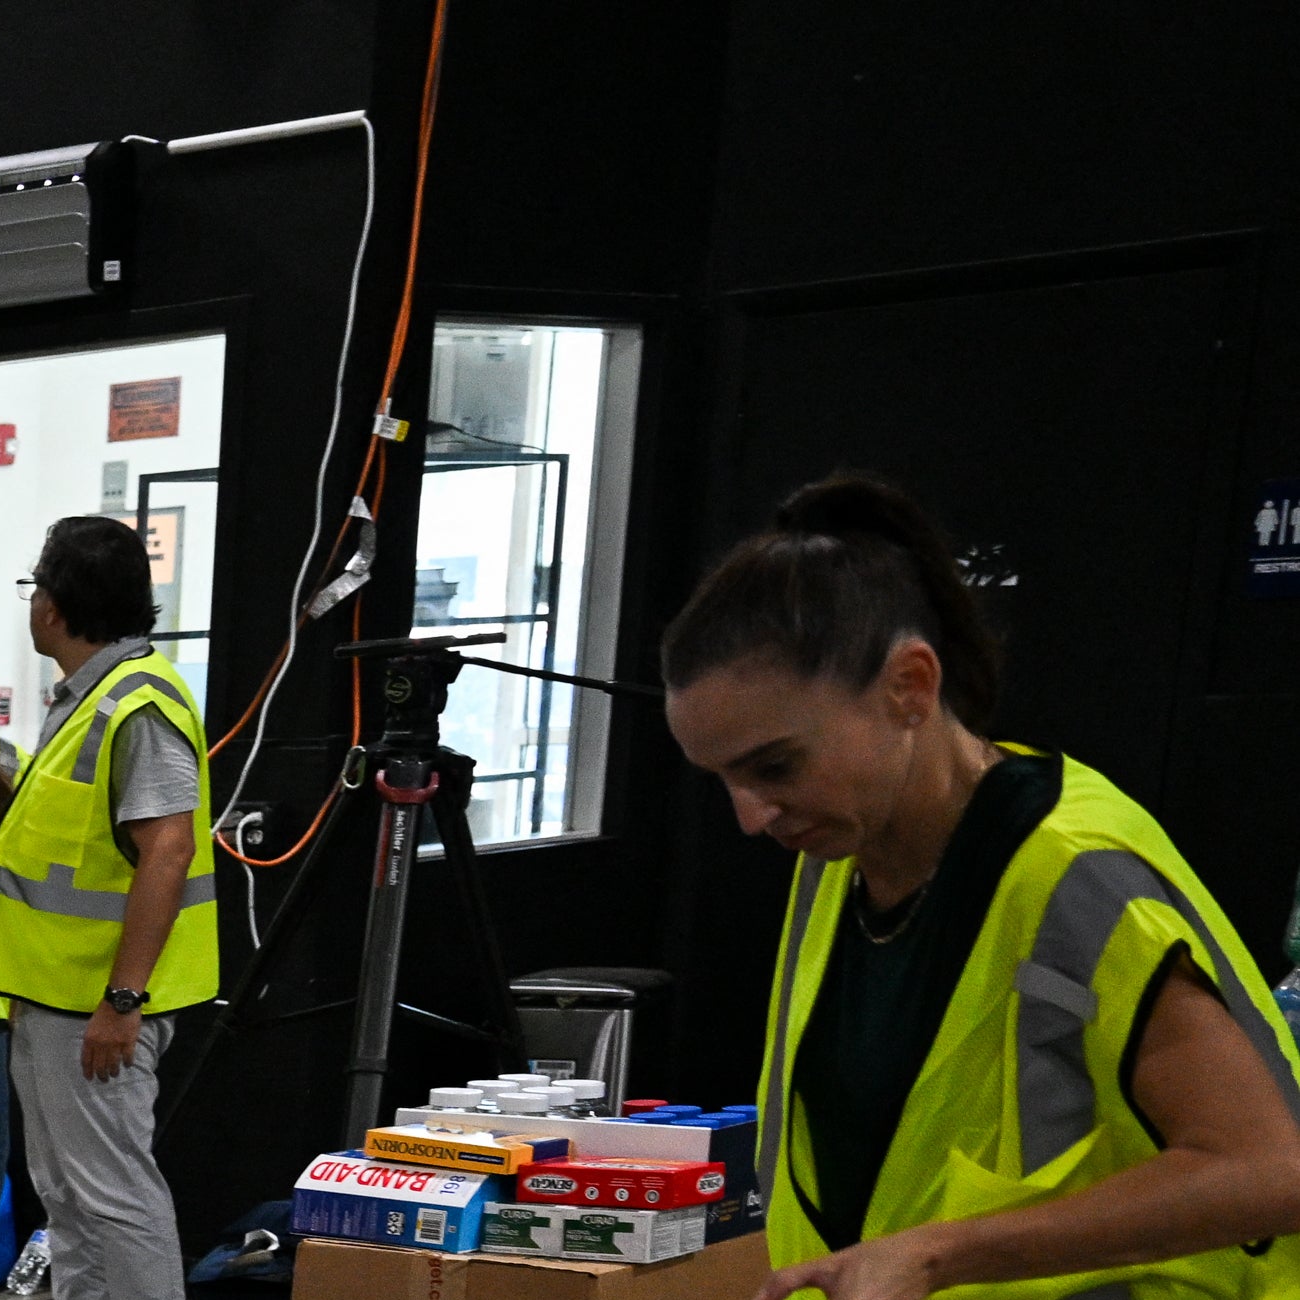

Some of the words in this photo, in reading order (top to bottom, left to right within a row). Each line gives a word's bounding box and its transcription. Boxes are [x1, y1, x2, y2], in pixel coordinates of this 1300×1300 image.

[1253, 561, 1300, 574] RESTRO
[371, 1138, 457, 1161] NEOSPORIN
[309, 1161, 436, 1192] BAND-AID
[439, 1175, 466, 1195] 198
[528, 1177, 575, 1190] BENGAY
[501, 1209, 532, 1220] CURAD
[582, 1215, 614, 1225] CURAD
